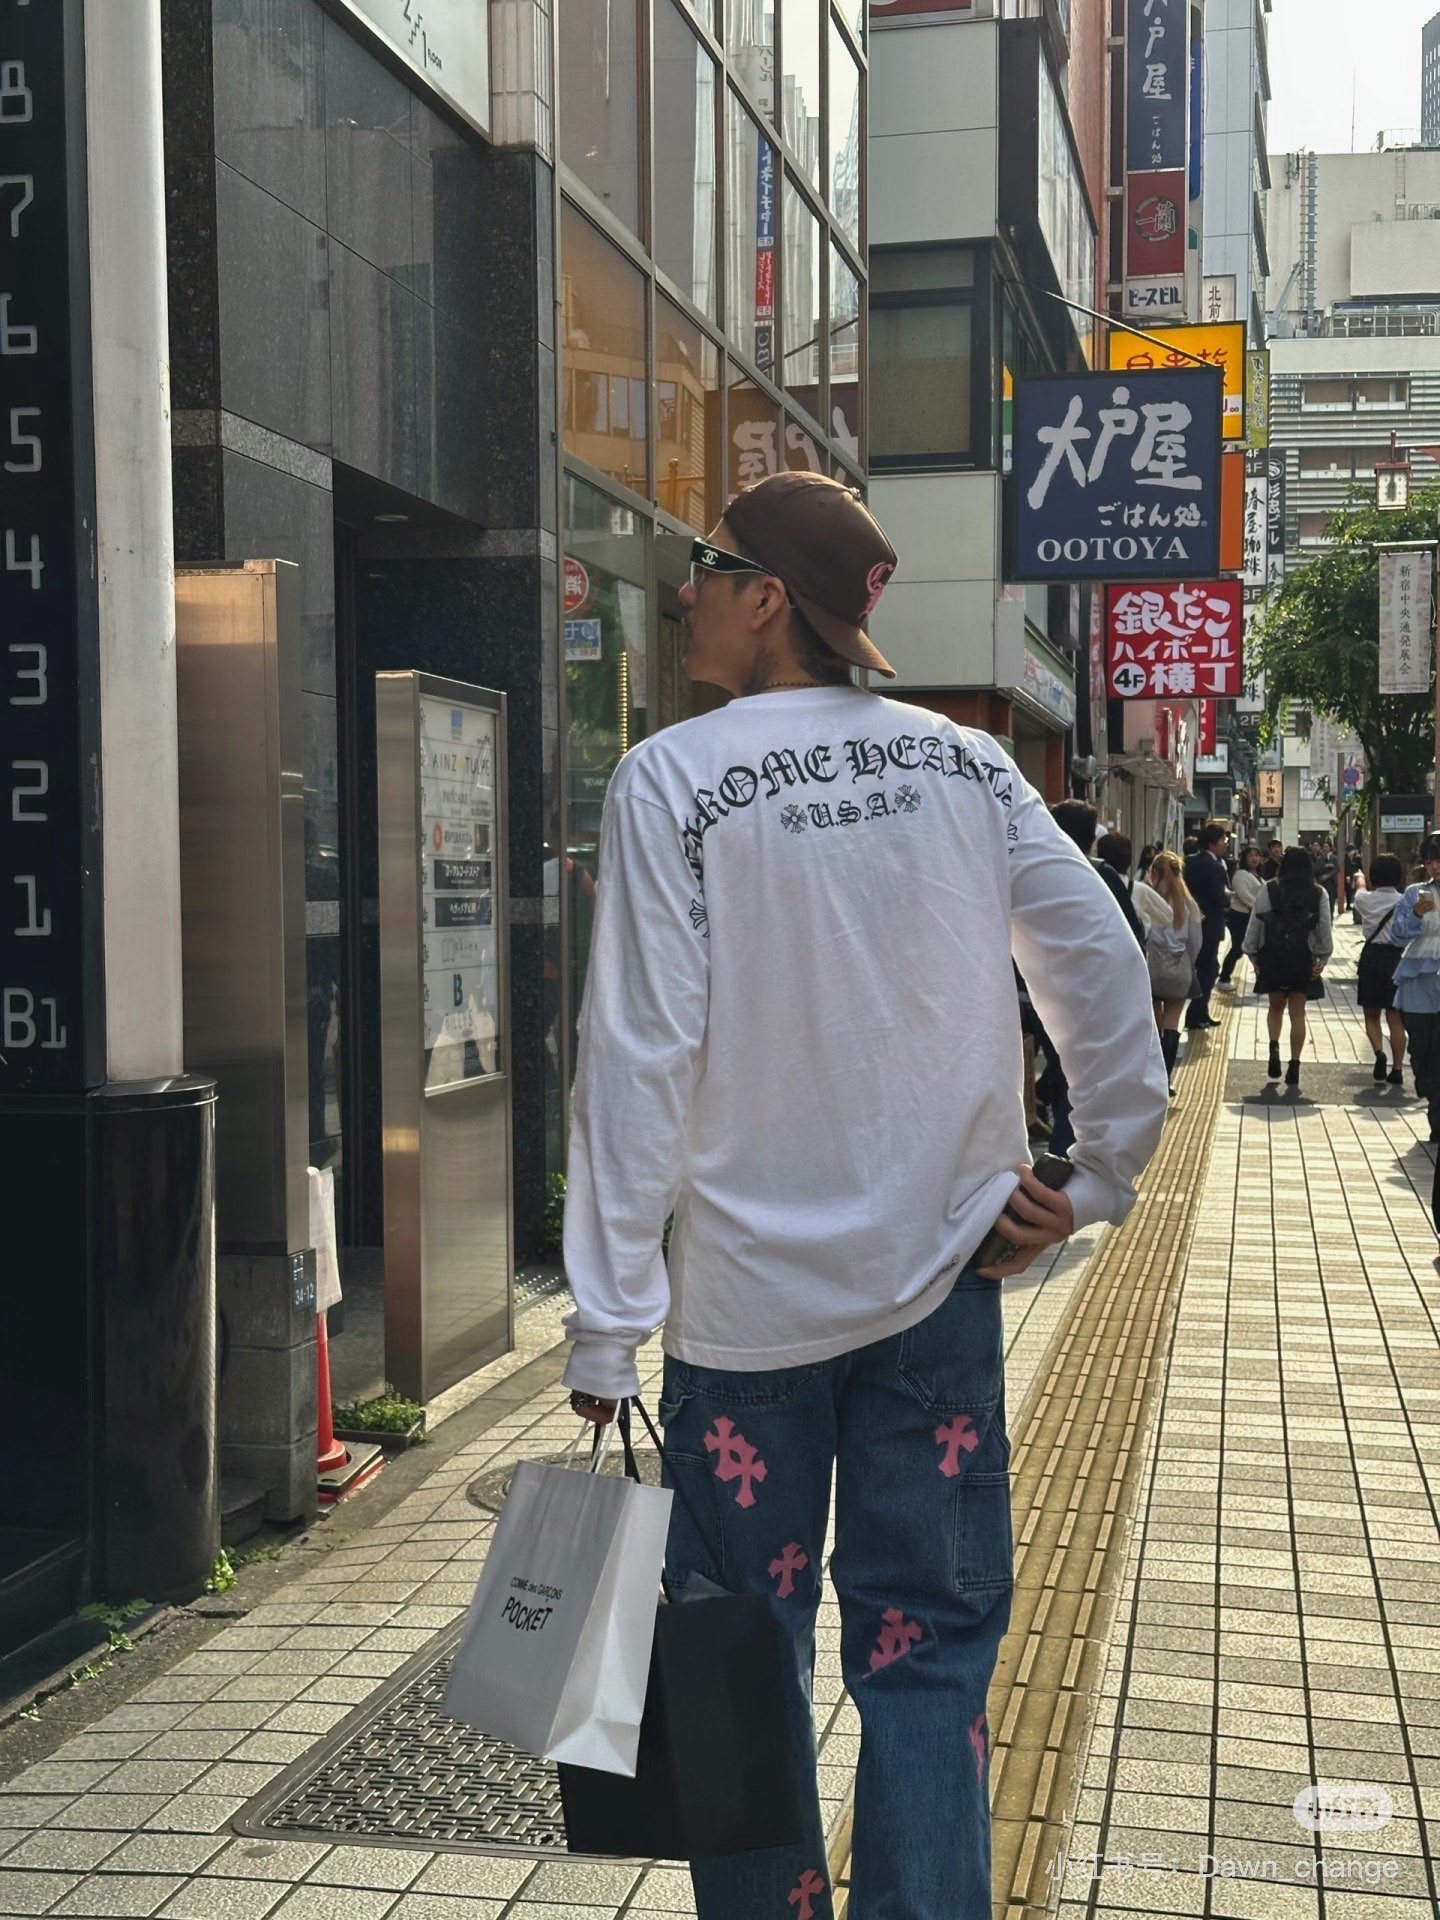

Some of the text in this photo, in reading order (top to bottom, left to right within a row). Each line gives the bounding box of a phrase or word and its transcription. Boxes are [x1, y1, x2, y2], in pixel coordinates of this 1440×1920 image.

[0, 60, 33, 123] 8
[0, 174, 34, 238] 7
[0, 293, 38, 355] 6
[1128, 285, 1182, 308] ピースビル
[4, 406, 42, 472] 5
[1027, 386, 1203, 510] 大戸屋
[1098, 502, 1201, 528] ごはん処
[6, 528, 45, 590] 4
[1037, 537, 1190, 562] OOTOYA
[1113, 583, 1232, 638] 銀だこ
[1399, 564, 1412, 676] 新宿中央通発展会
[8, 643, 48, 706] 3
[1112, 636, 1235, 662] ハイボール
[1114, 668, 1145, 688] 4F
[1150, 662, 1235, 695] 横丁
[12, 760, 49, 822] 2
[433, 753, 457, 772] AINZ
[808, 791, 897, 828] U.S.A.
[14, 875, 52, 936] 1
[3, 987, 67, 1049] B1
[501, 1596, 553, 1632] POCKET
